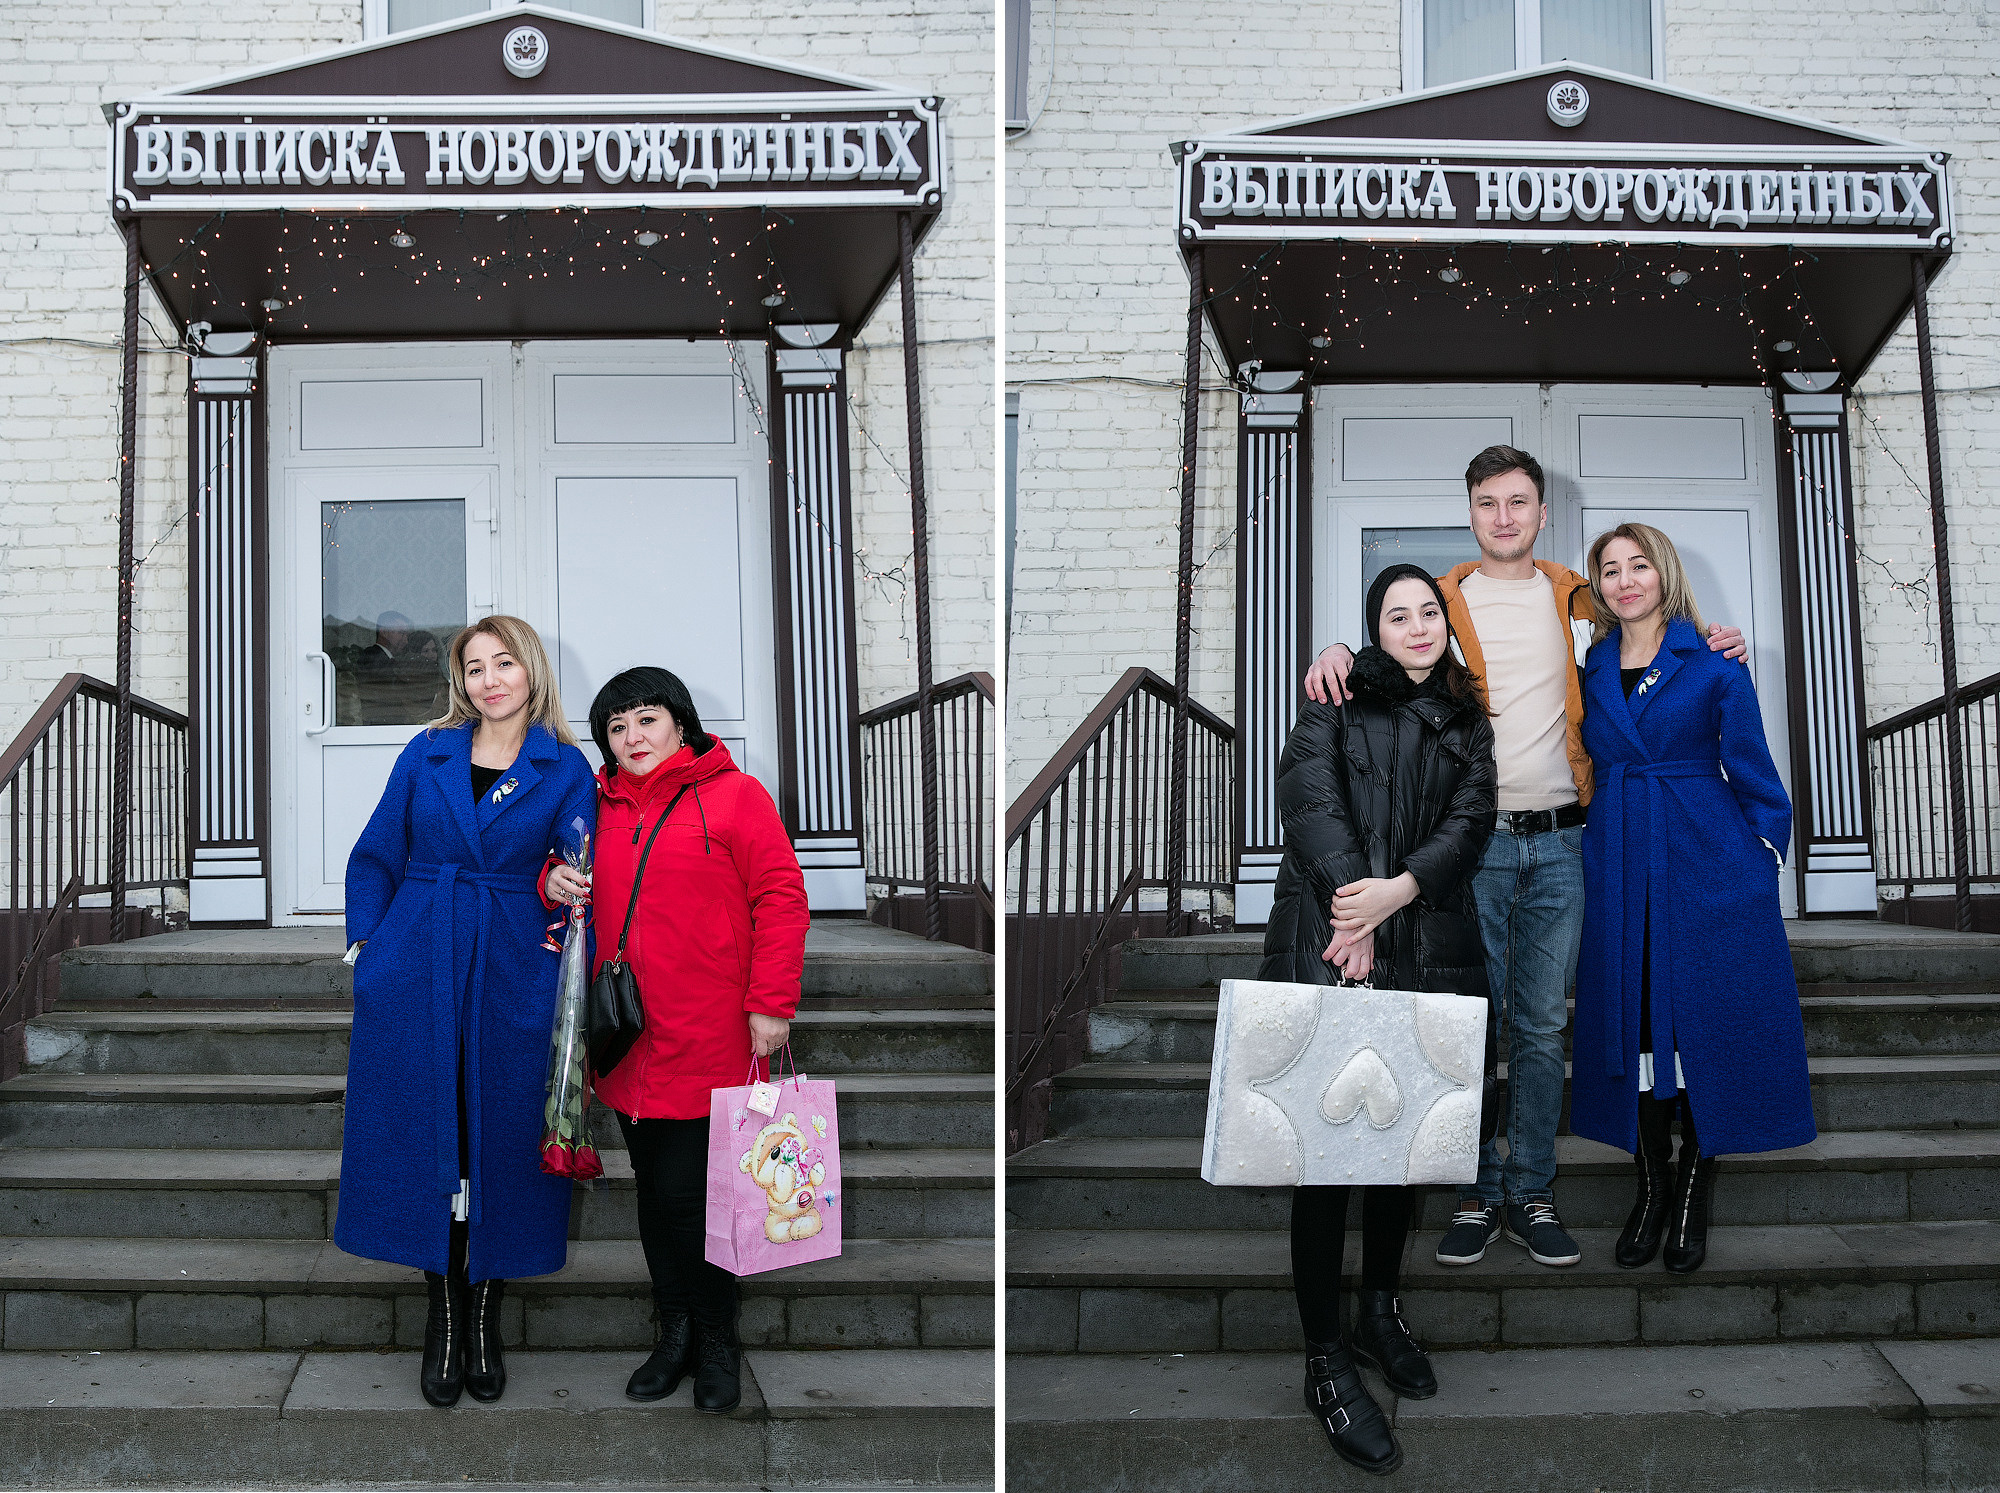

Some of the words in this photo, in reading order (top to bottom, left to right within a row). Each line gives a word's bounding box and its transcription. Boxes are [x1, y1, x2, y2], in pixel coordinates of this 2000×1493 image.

[132, 123, 405, 186] ВЫПИСКА
[424, 121, 922, 190] НОВОРОЖДЕННЫХ
[1199, 161, 1456, 220] ВЫПИСКА
[1475, 166, 1935, 230] НОВОРОЖДЕННЫХ
